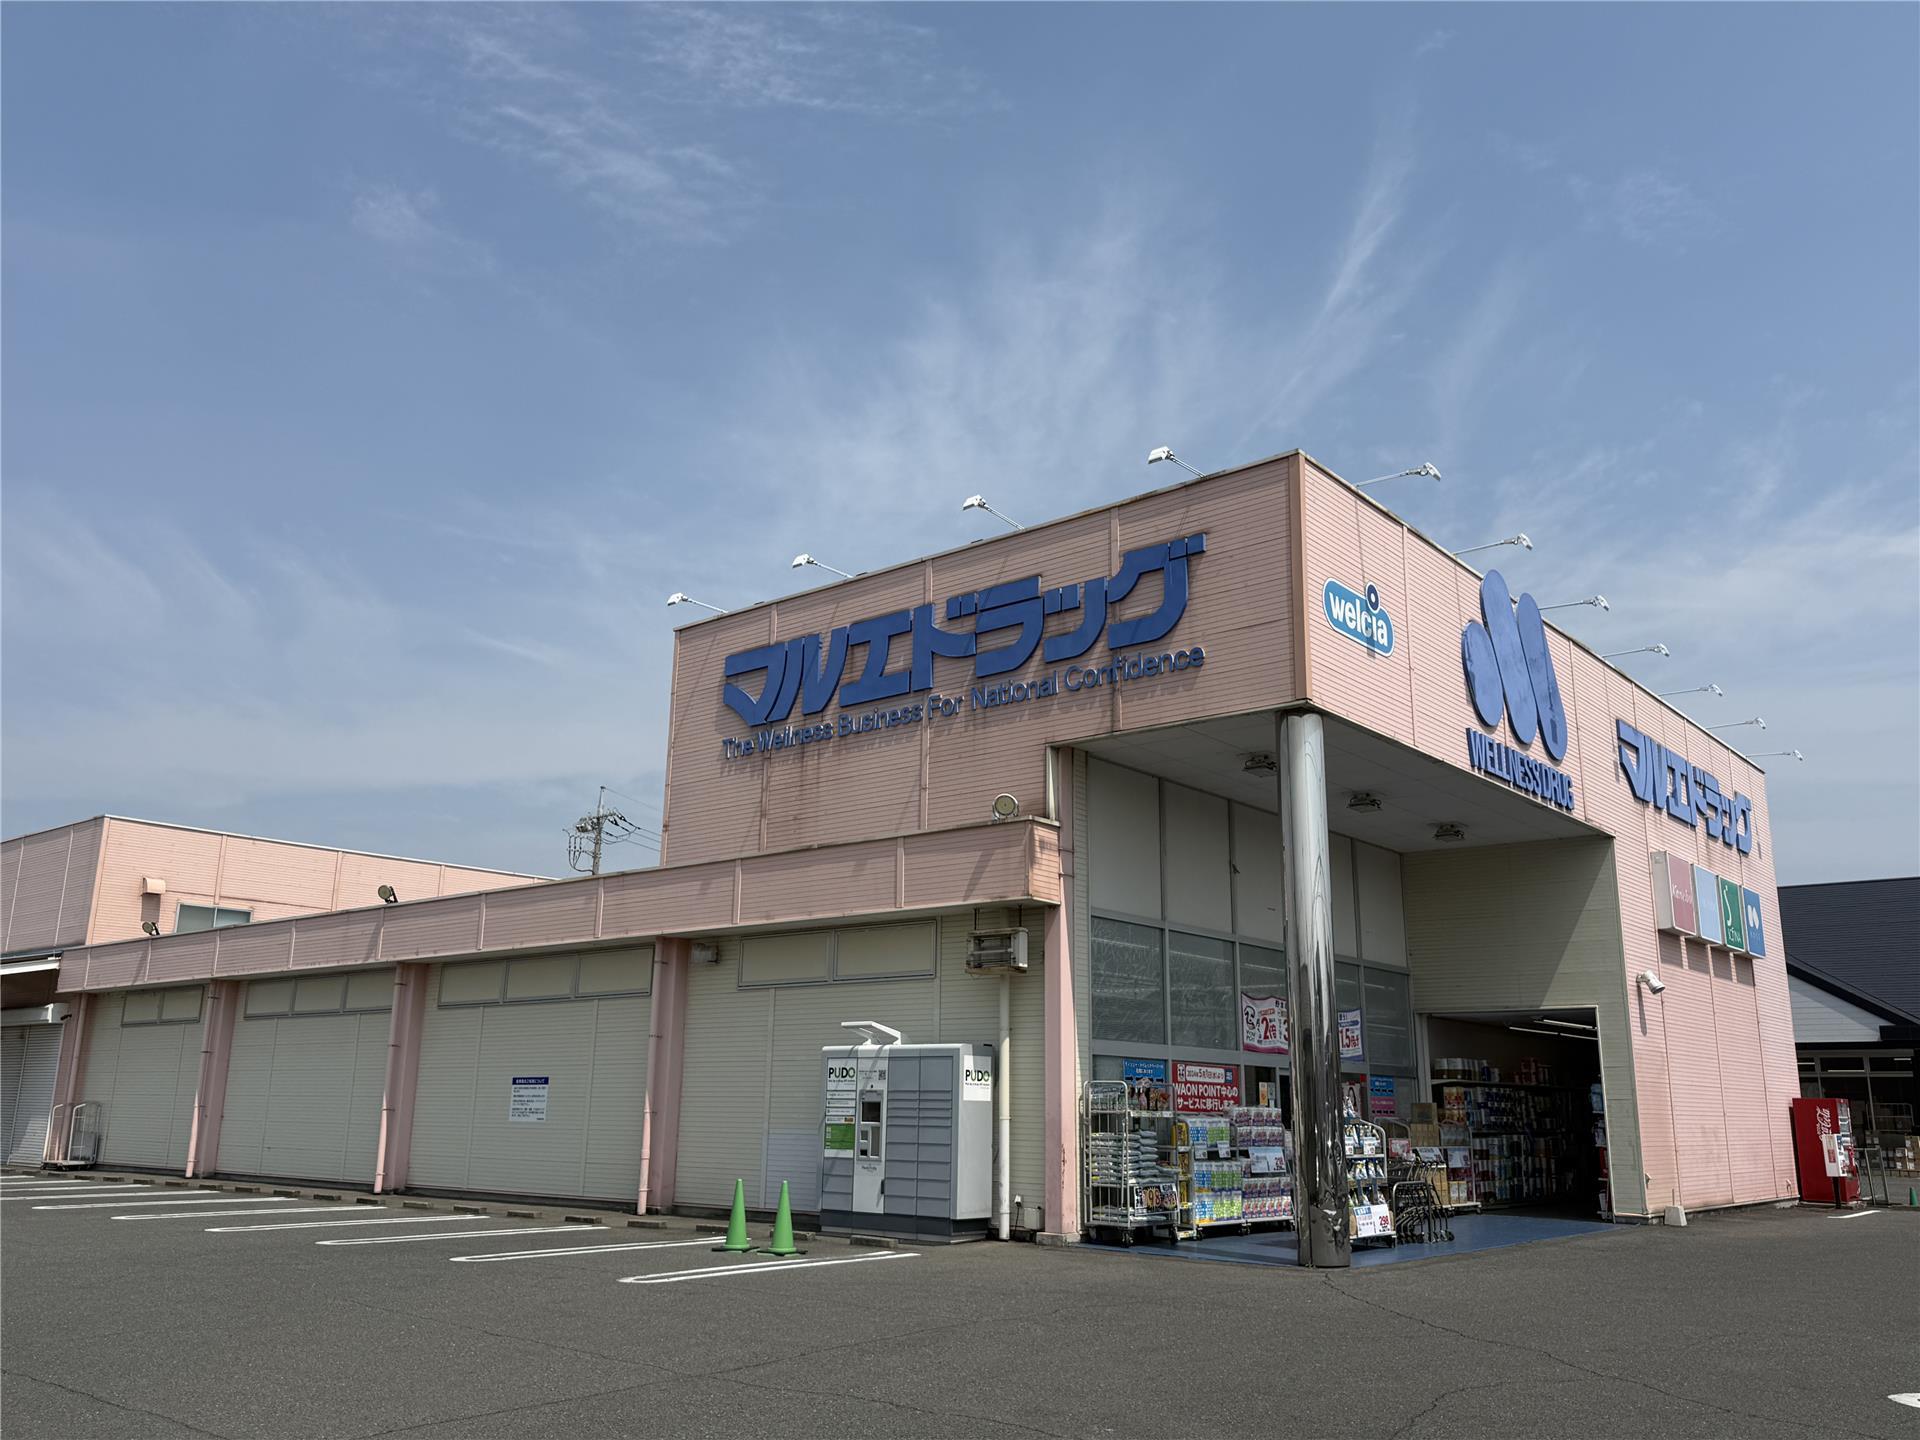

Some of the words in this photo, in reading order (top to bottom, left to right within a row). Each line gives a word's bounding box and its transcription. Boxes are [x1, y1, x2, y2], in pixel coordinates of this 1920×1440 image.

[723, 533, 1206, 727] マルエドラッグ
[1328, 584, 1389, 647] welcia
[722, 737, 755, 760] The
[757, 721, 834, 752] Wellness
[838, 703, 924, 737] Business
[927, 694, 964, 720] For
[970, 670, 1059, 712] National
[1064, 647, 1206, 691] Confidence
[1616, 719, 1752, 855] マルエドラッグ
[828, 1067, 856, 1079] PUDO
[965, 1069, 990, 1082] PUDO
[1172, 1082, 1198, 1097] WAON
